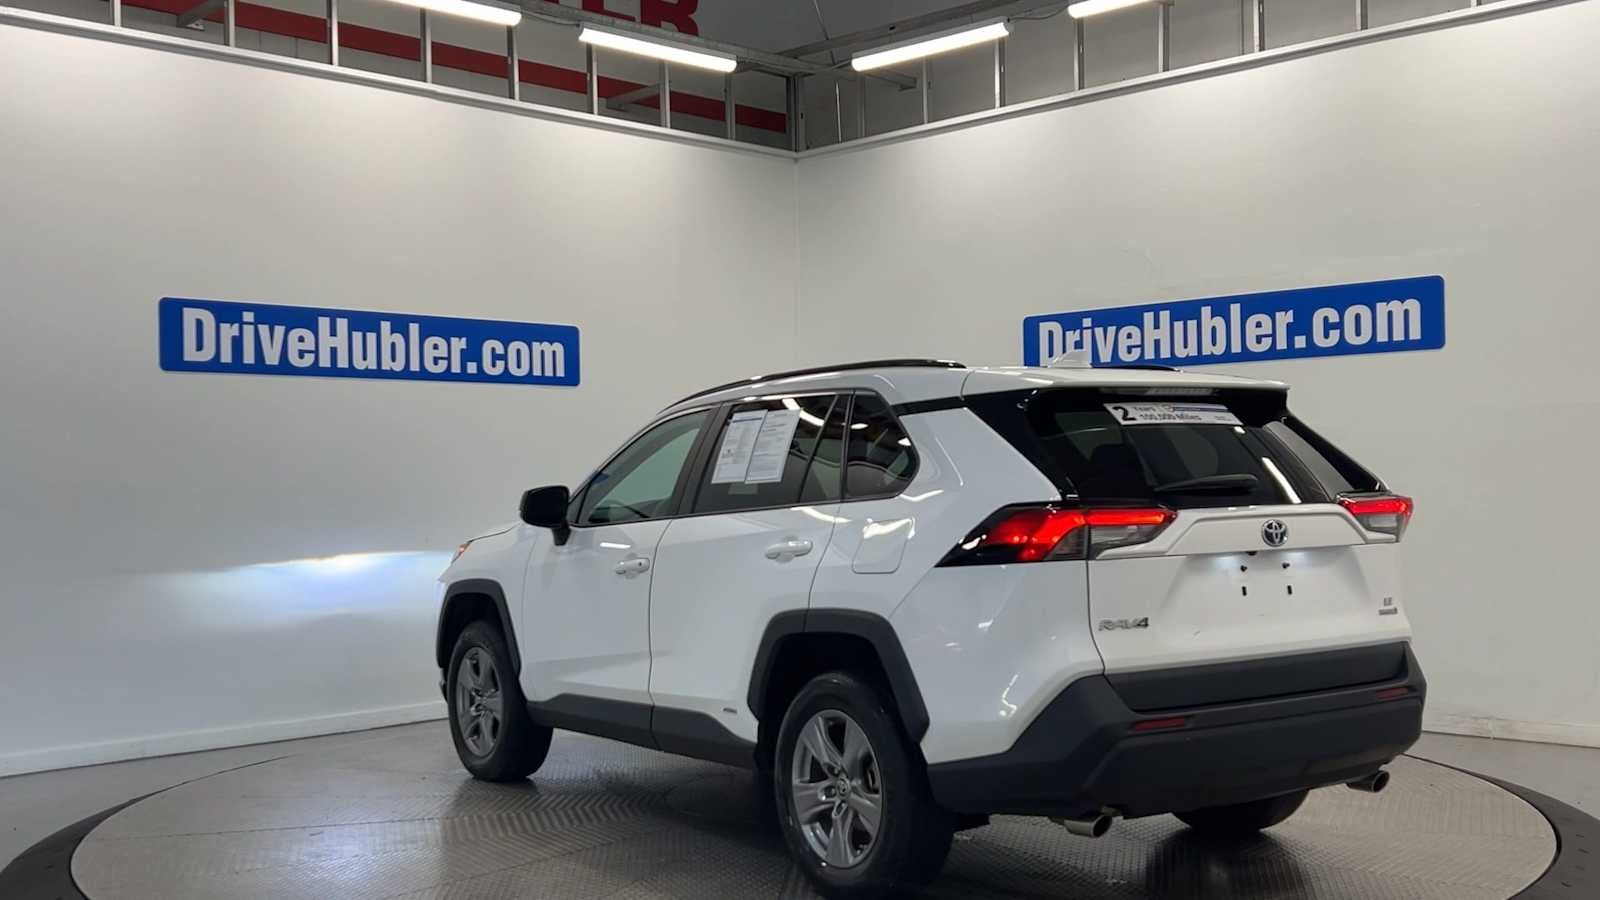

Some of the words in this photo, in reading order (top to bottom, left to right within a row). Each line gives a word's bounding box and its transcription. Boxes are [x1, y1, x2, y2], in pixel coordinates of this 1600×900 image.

[182, 307, 565, 378] DriveHubler.com
[1112, 406, 1137, 421] 2
[1099, 616, 1149, 631] RAV4
